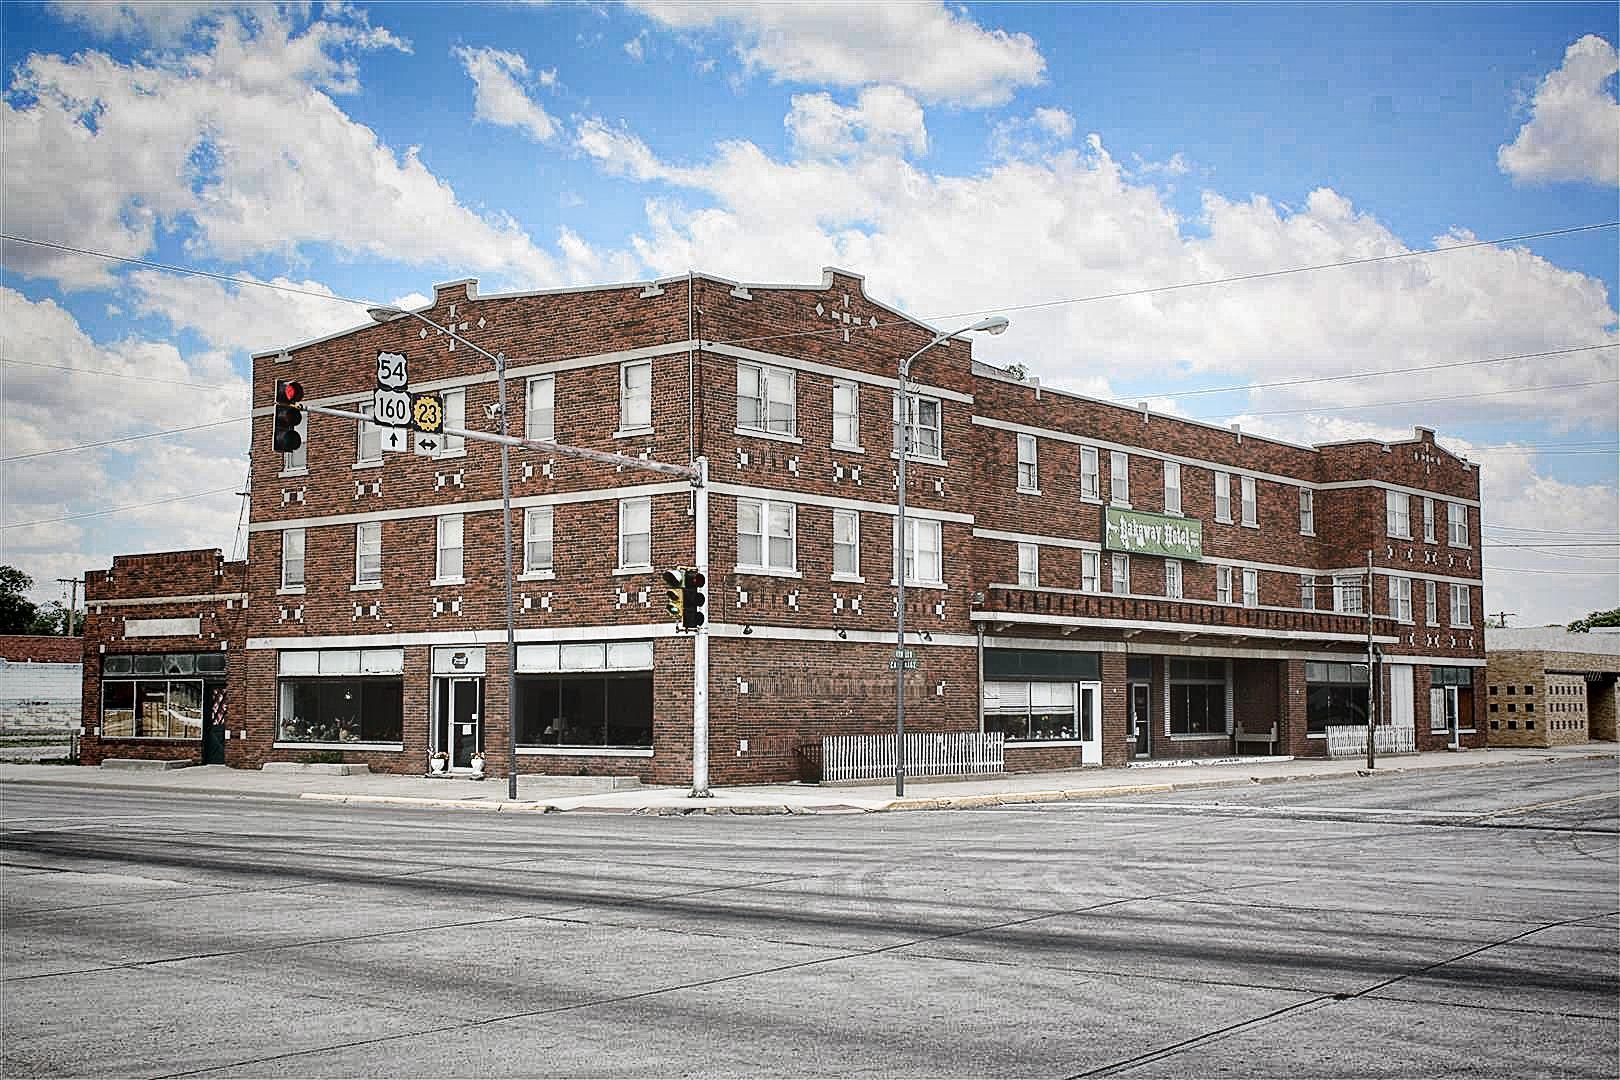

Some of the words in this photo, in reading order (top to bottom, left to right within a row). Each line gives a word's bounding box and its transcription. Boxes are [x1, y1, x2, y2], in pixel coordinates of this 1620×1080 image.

[381, 360, 404, 381] 54
[380, 398, 405, 419] 160
[419, 404, 436, 423] 23
[1165, 523, 1189, 546] Hotel
